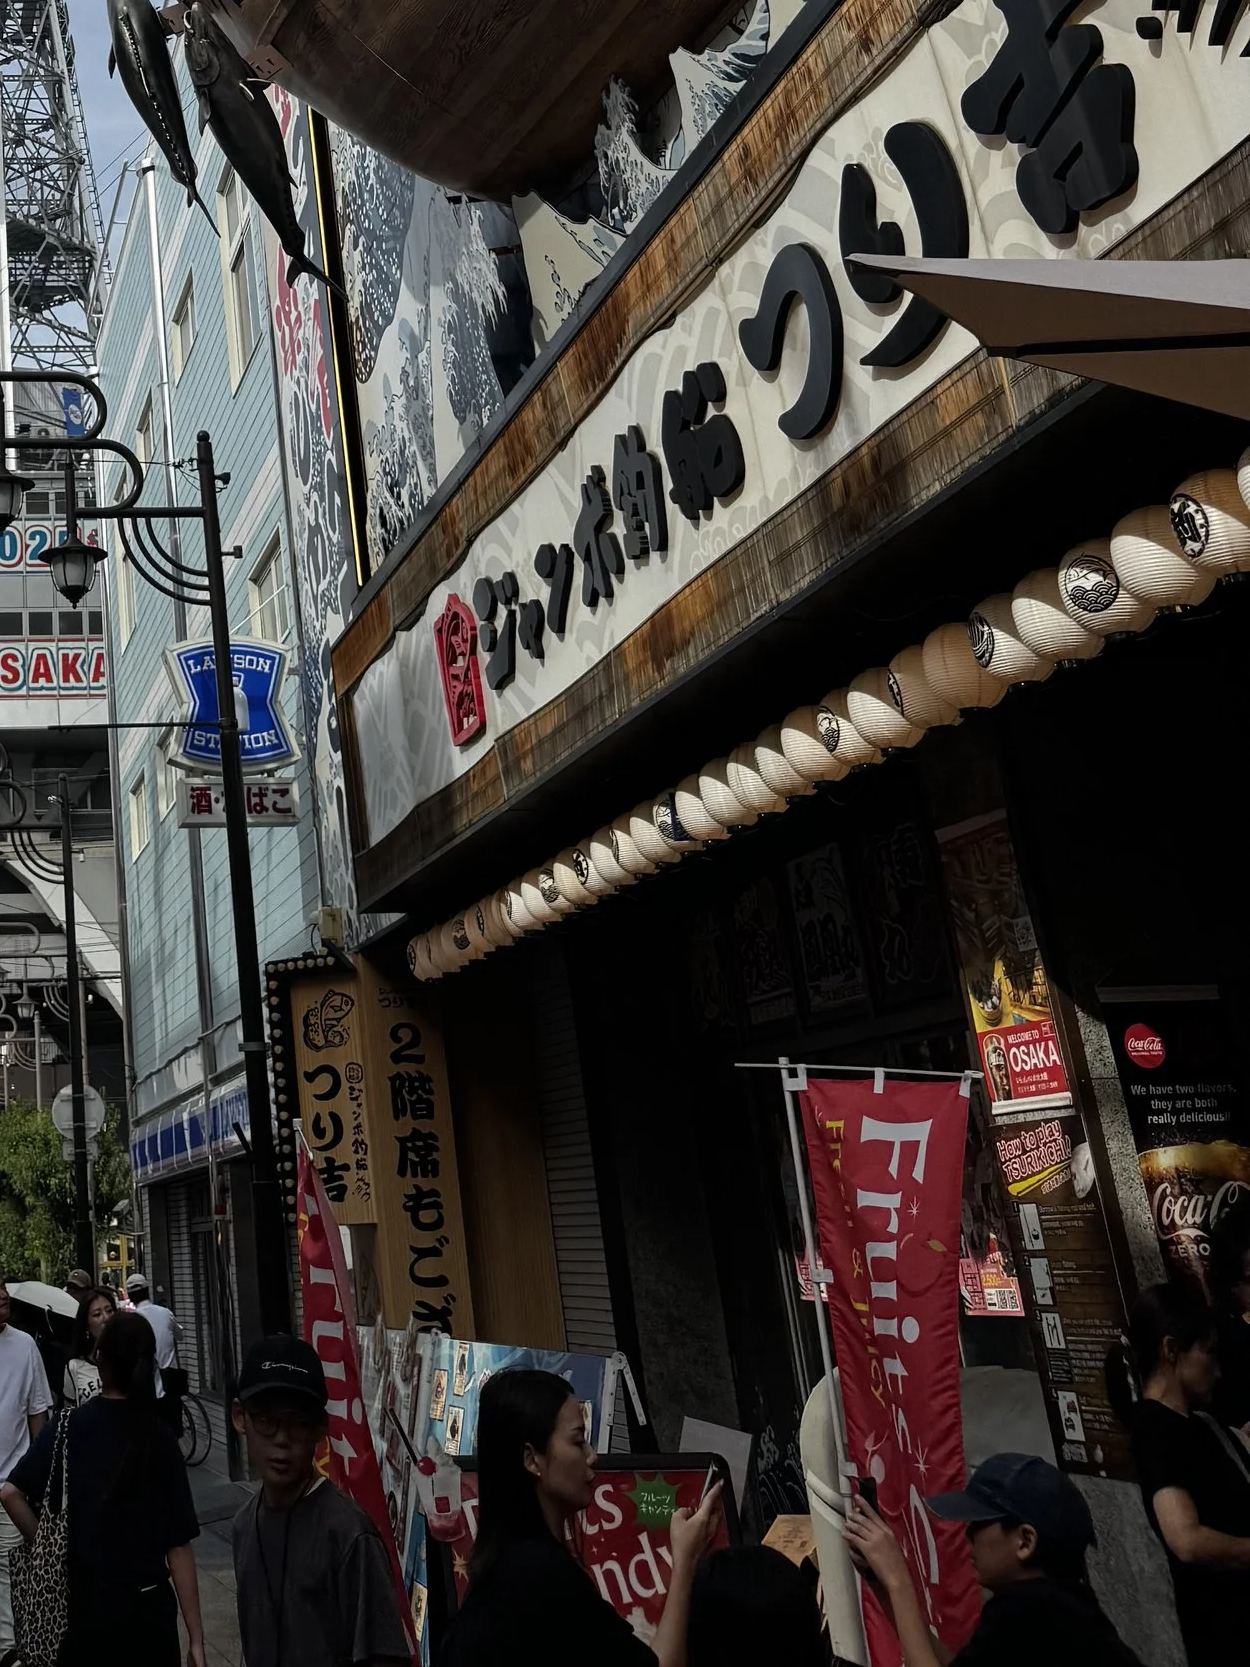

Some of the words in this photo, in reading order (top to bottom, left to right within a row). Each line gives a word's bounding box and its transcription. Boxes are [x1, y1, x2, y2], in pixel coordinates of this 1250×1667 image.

[188, 654, 273, 674] LASON
[193, 729, 280, 750] STION
[189, 787, 292, 814] 酒・ばこ
[1010, 1040, 1062, 1073] OSAKA
[1130, 1084, 1147, 1096] We
[1149, 1084, 1173, 1095] have
[1176, 1084, 1195, 1094] two
[1150, 1098, 1173, 1111] they
[1175, 1100, 1192, 1109] are
[1194, 1097, 1218, 1109] both
[1147, 1112, 1177, 1126] really
[303, 1063, 352, 1203] つり吉
[996, 1137, 1023, 1162] How
[1020, 1130, 1037, 1151] to
[1035, 1119, 1063, 1147] play
[640, 1491, 672, 1504] フルーツ
